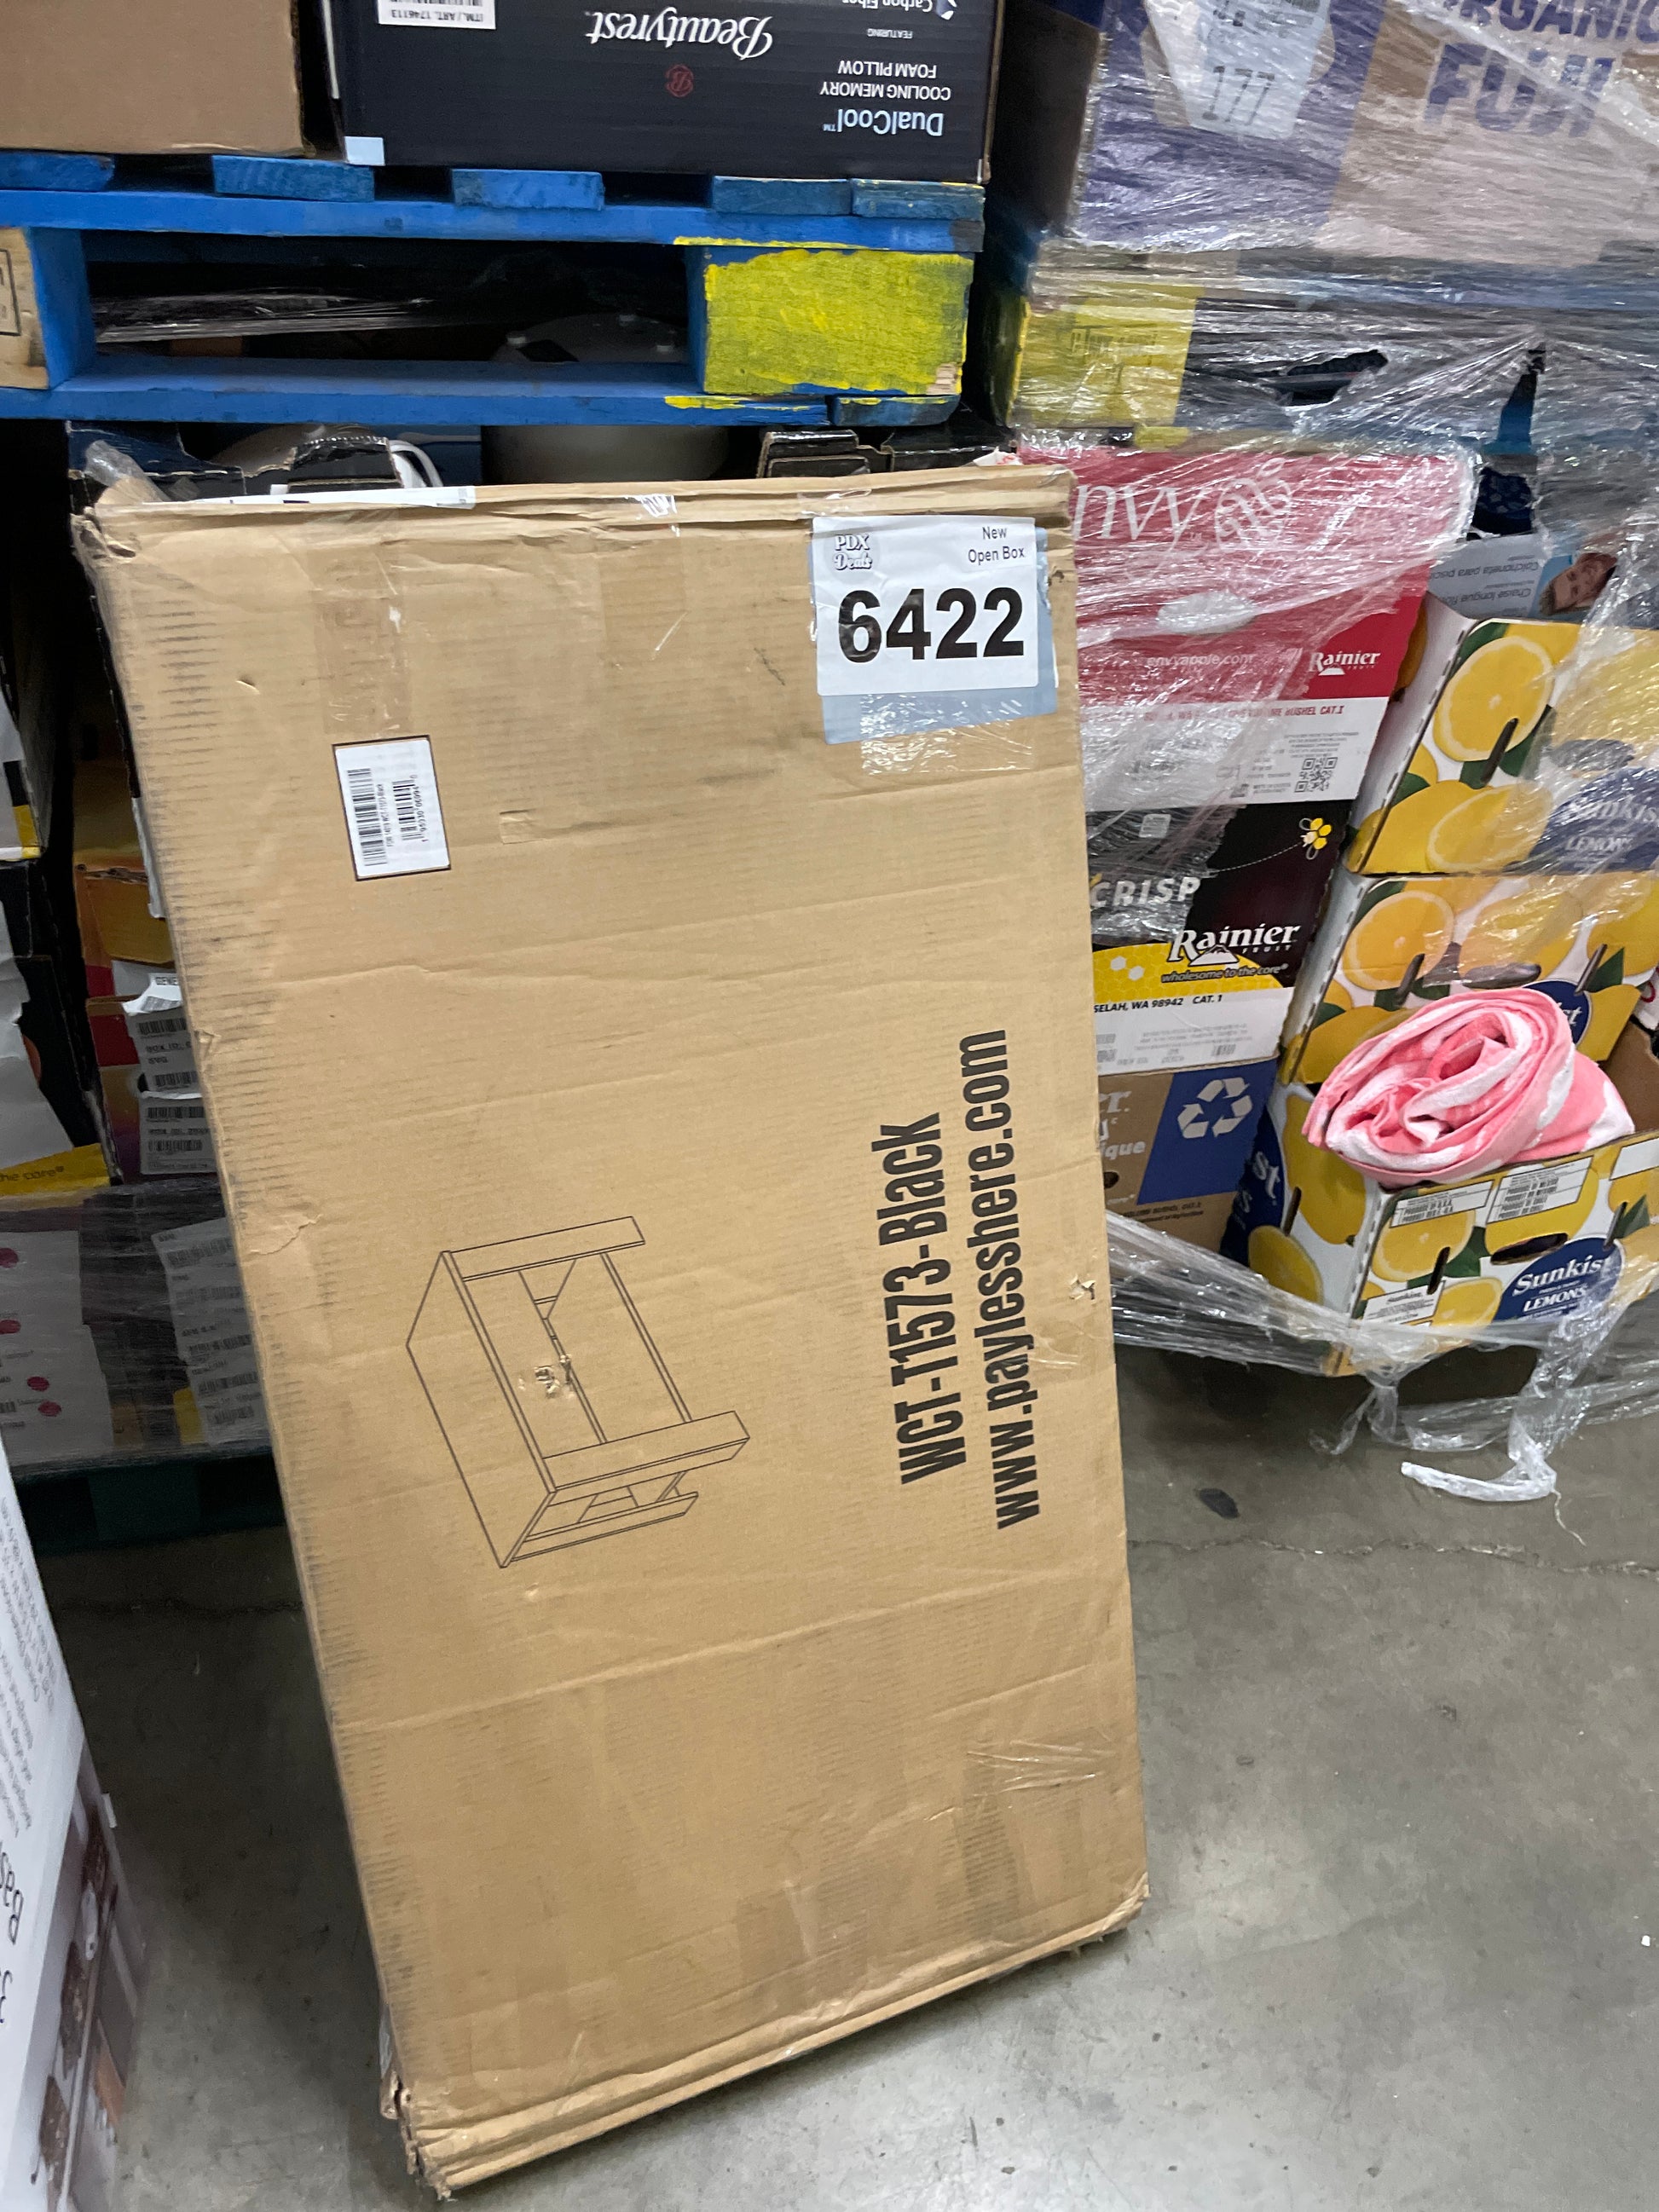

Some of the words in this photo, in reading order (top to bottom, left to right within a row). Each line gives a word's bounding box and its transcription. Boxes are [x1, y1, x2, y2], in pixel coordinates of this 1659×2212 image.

[841, 0, 879, 9] Fib
[585, 7, 773, 61] Beautyrest
[866, 28, 913, 39] FEATURING
[838, 61, 893, 77] PILLOW
[895, 62, 937, 78] FOAM
[819, 81, 884, 98] MEMORY
[887, 84, 951, 101] COOLING
[1072, 483, 1209, 561] nvy
[982, 526, 1008, 540] New
[835, 534, 870, 551] PDX
[834, 553, 873, 570] Deals
[968, 548, 999, 566] Open
[1003, 546, 1026, 559] Box
[838, 586, 1025, 663] 6422
[1308, 650, 1381, 673] Rainier
[1090, 875, 1201, 909] CRISP
[1167, 922, 1302, 962] Rainier
[1161, 967, 1223, 984] wholesome
[1224, 967, 1236, 978] to
[1237, 966, 1257, 977] the
[1094, 1001, 1128, 1014] SELAH,
[1130, 1000, 1149, 1010] WA
[1152, 998, 1183, 1008] 98942
[1192, 995, 1215, 1005] CAT.
[959, 1029, 1041, 1531] www.paylesshere.com
[1523, 1285, 1588, 1313] LEMONS
